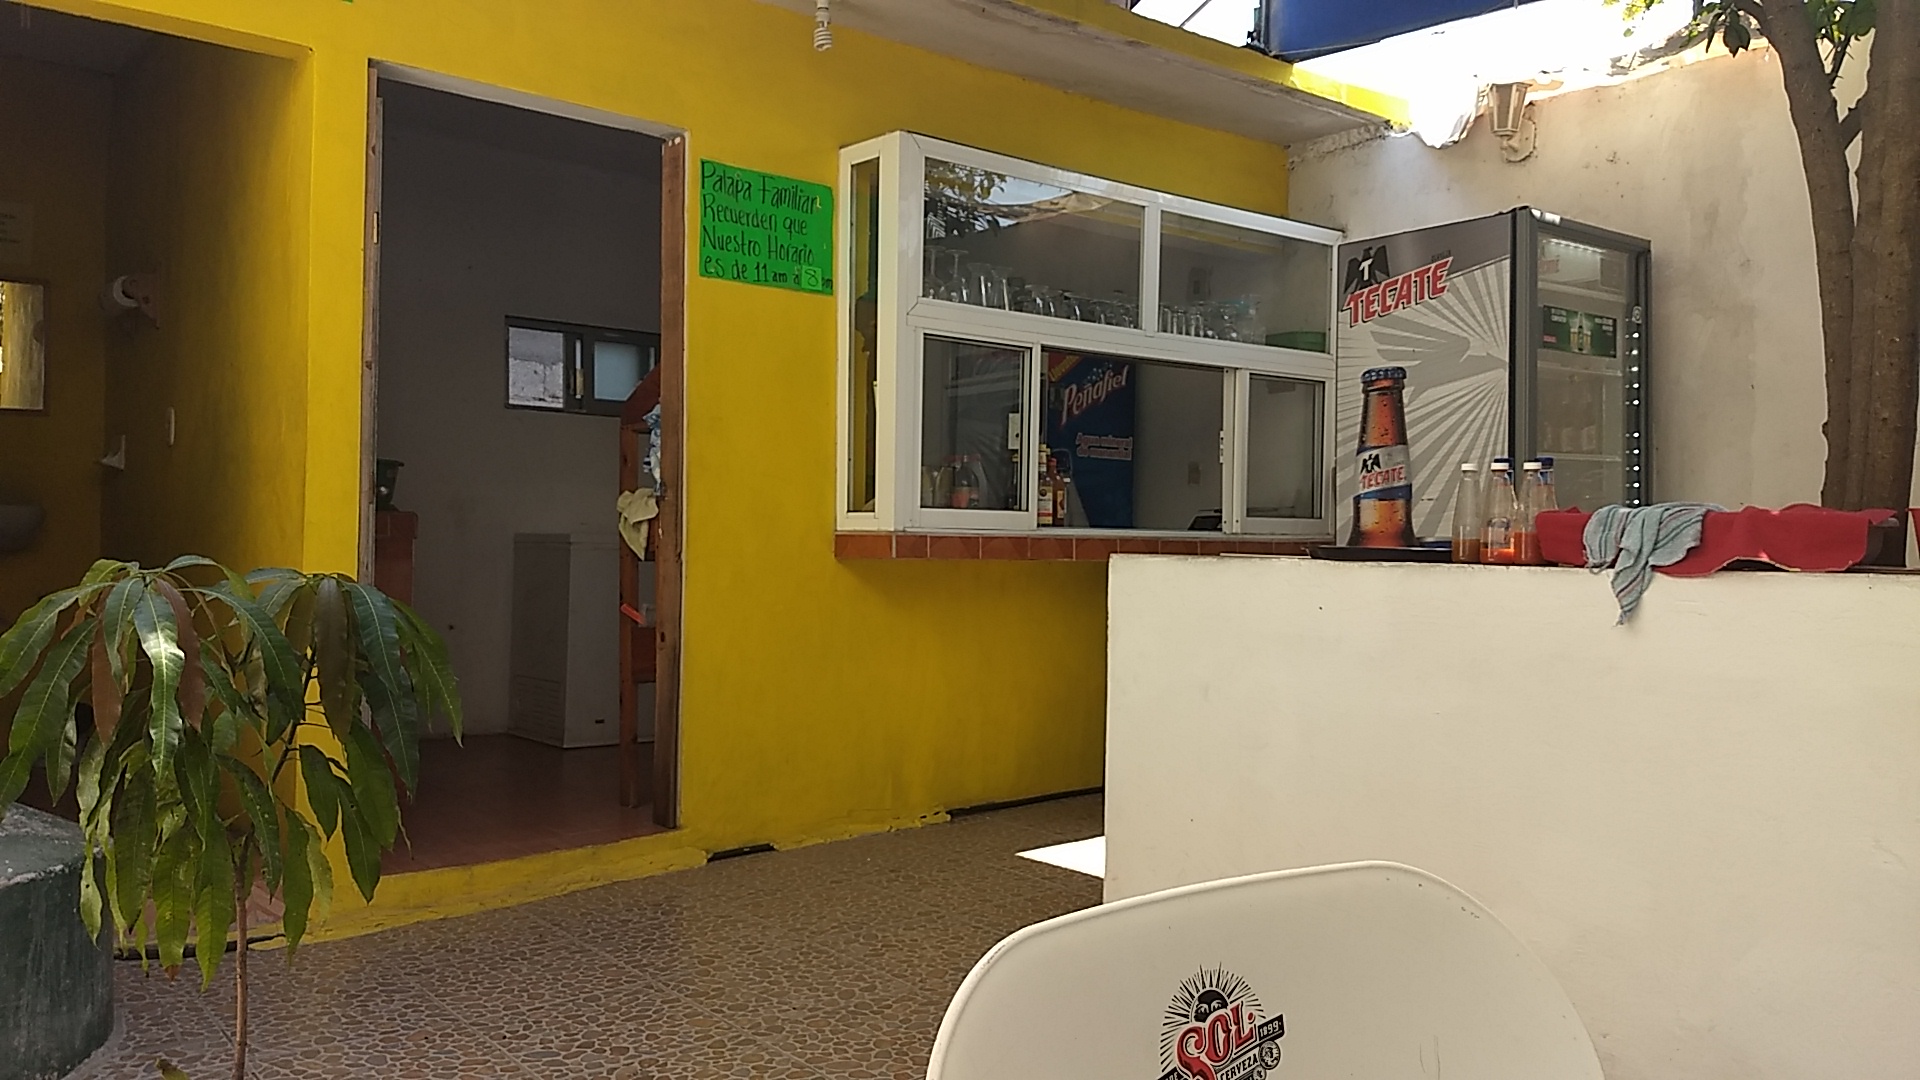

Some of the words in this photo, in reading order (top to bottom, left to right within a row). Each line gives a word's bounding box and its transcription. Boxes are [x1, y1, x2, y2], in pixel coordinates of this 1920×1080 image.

[701, 160, 752, 203] Palapa
[757, 174, 817, 215] Familiar
[702, 193, 777, 233] Recuerden
[782, 216, 808, 240] que
[702, 225, 761, 257] Nuestro
[767, 234, 815, 266] Horario
[704, 255, 725, 279] es
[731, 259, 748, 280] de
[804, 268, 819, 288] 8
[1341, 256, 1454, 328] TECATE
[1061, 364, 1130, 426] Peñafiel
[1359, 464, 1406, 490] TECATE
[1259, 1019, 1280, 1038] 1899
[1220, 1053, 1259, 1080] CERVEZA
